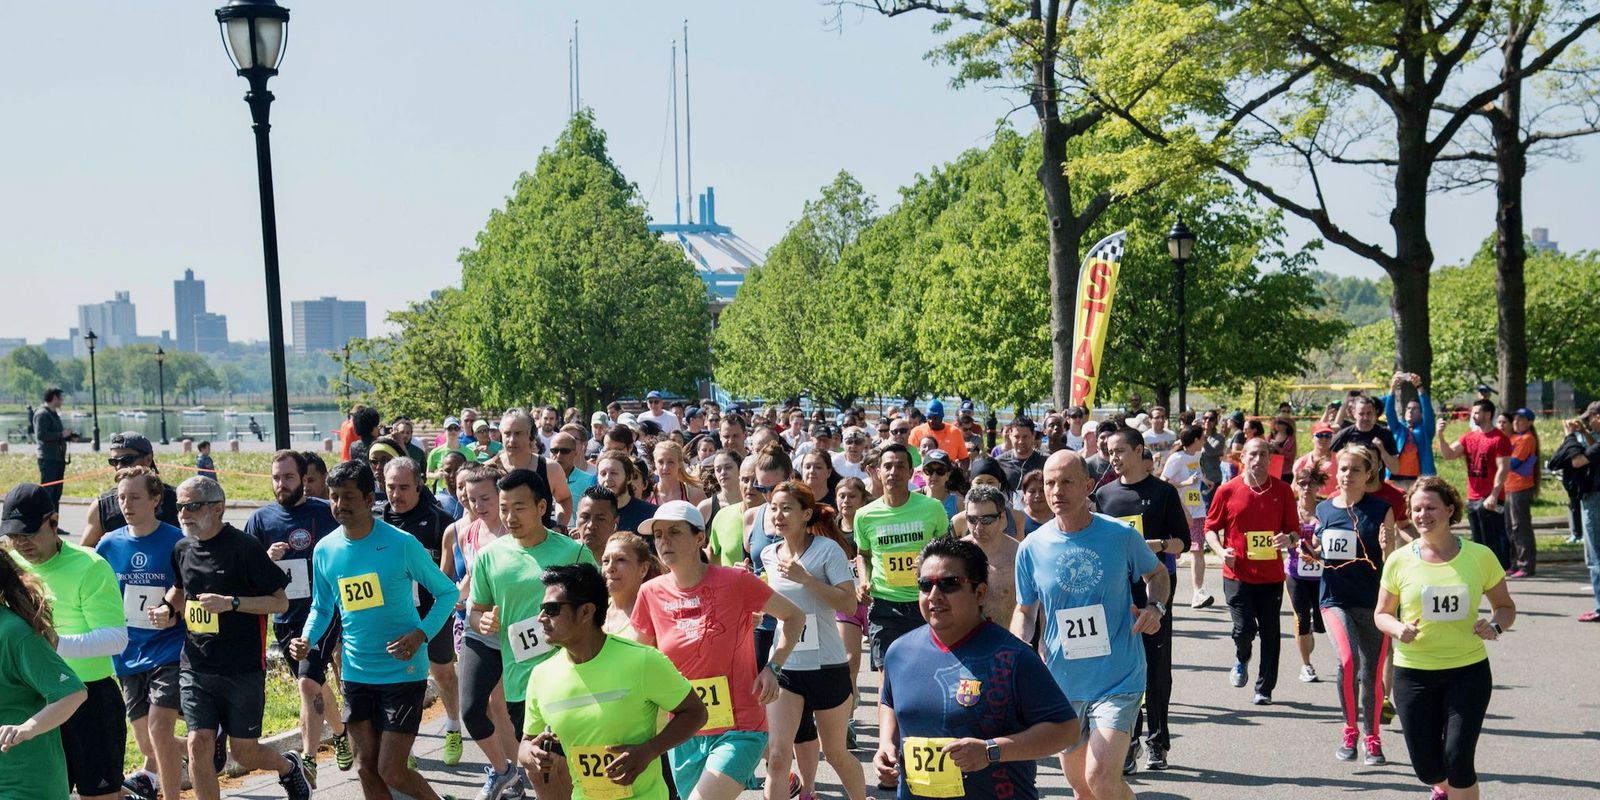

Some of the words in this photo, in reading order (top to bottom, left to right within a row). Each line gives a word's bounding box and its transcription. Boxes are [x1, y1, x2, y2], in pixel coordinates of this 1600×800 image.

[877, 531, 924, 546] NUTRITION
[1328, 538, 1348, 553] 162
[889, 556, 913, 572] 519
[116, 572, 166, 581] BROOKSTONE
[1056, 576, 1090, 593] MARATHON
[1091, 569, 1104, 587] TEAM
[344, 581, 374, 602] 520
[139, 595, 148, 612] 7
[1432, 595, 1459, 613] 143
[189, 607, 211, 624] 800
[1065, 616, 1098, 639] 211
[518, 628, 539, 651] 15
[696, 684, 721, 707] 21
[912, 746, 946, 772] 527
